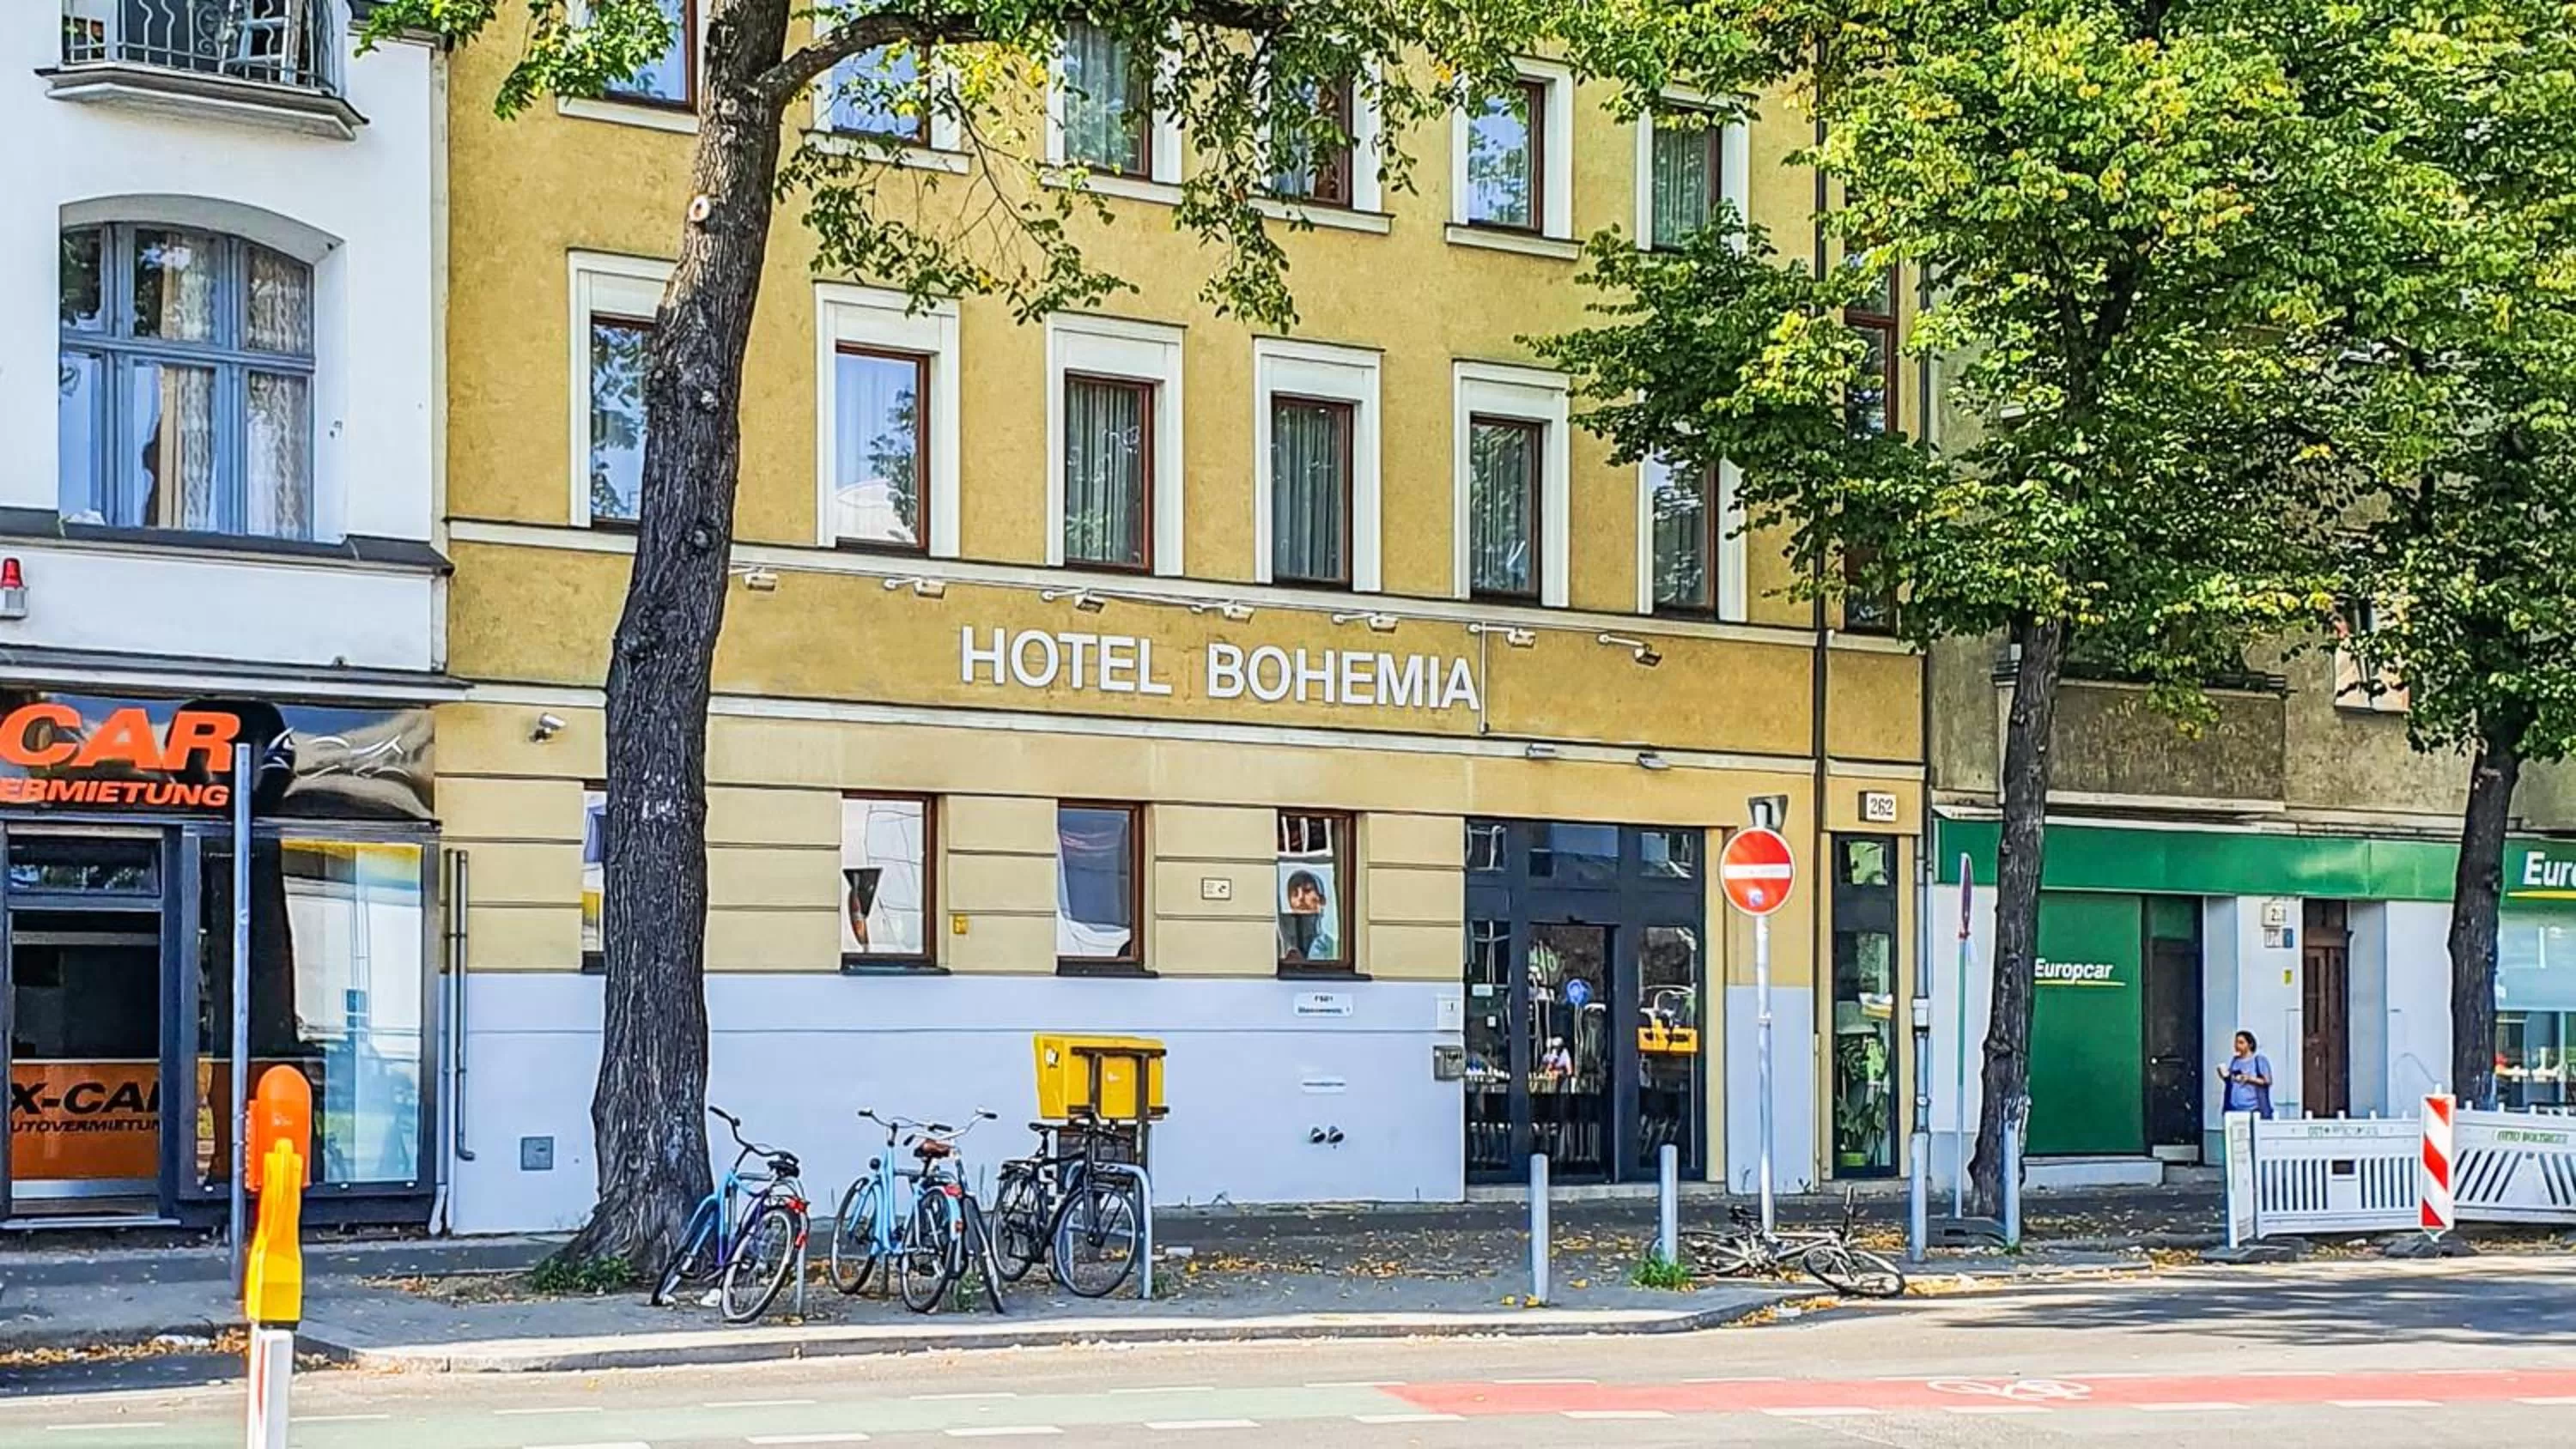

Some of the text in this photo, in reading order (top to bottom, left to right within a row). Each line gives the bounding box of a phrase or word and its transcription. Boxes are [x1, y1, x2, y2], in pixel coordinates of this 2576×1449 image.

[962, 626, 1480, 710] HOTEL BOHEMIA
[0, 703, 240, 772] CAR
[1869, 797, 1893, 815] 262
[2034, 958, 2113, 984] Europcar
